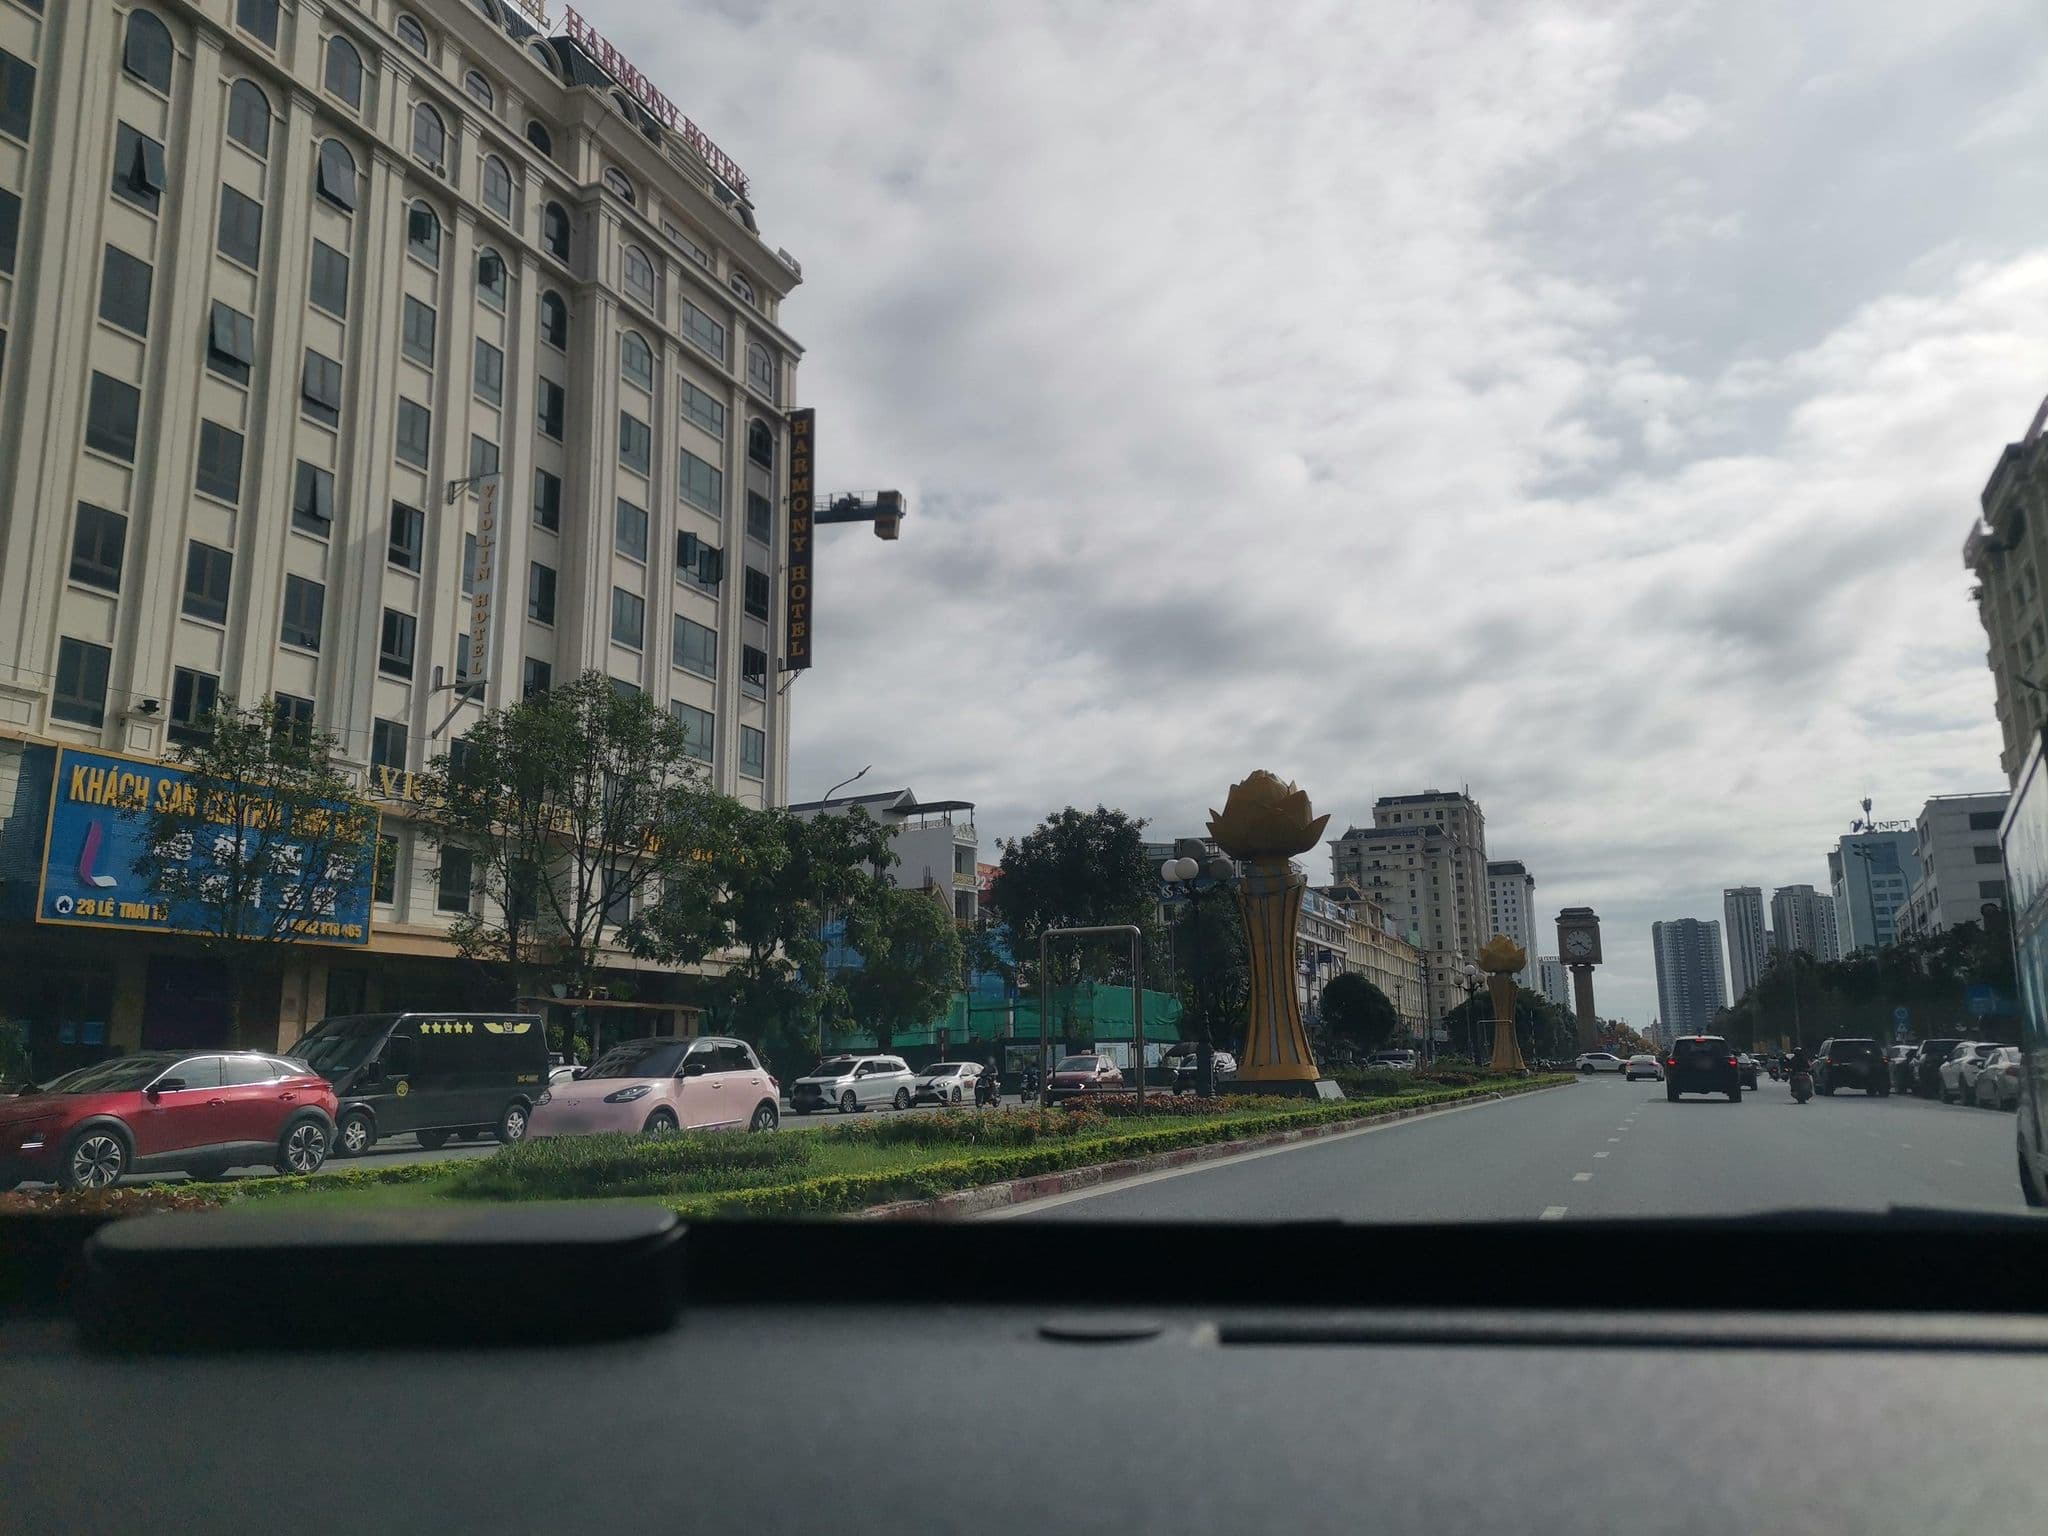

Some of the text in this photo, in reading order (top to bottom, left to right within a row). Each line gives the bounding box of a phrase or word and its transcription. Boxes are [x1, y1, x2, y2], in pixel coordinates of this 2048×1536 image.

[566, 5, 746, 194] HARMONY HOTEL
[472, 484, 496, 675] VIOLIN HOTEL
[791, 420, 808, 656] HARMONY HOTEL
[70, 764, 150, 811] KHÁCH
[76, 898, 95, 915] 28
[98, 897, 115, 917] LÊ
